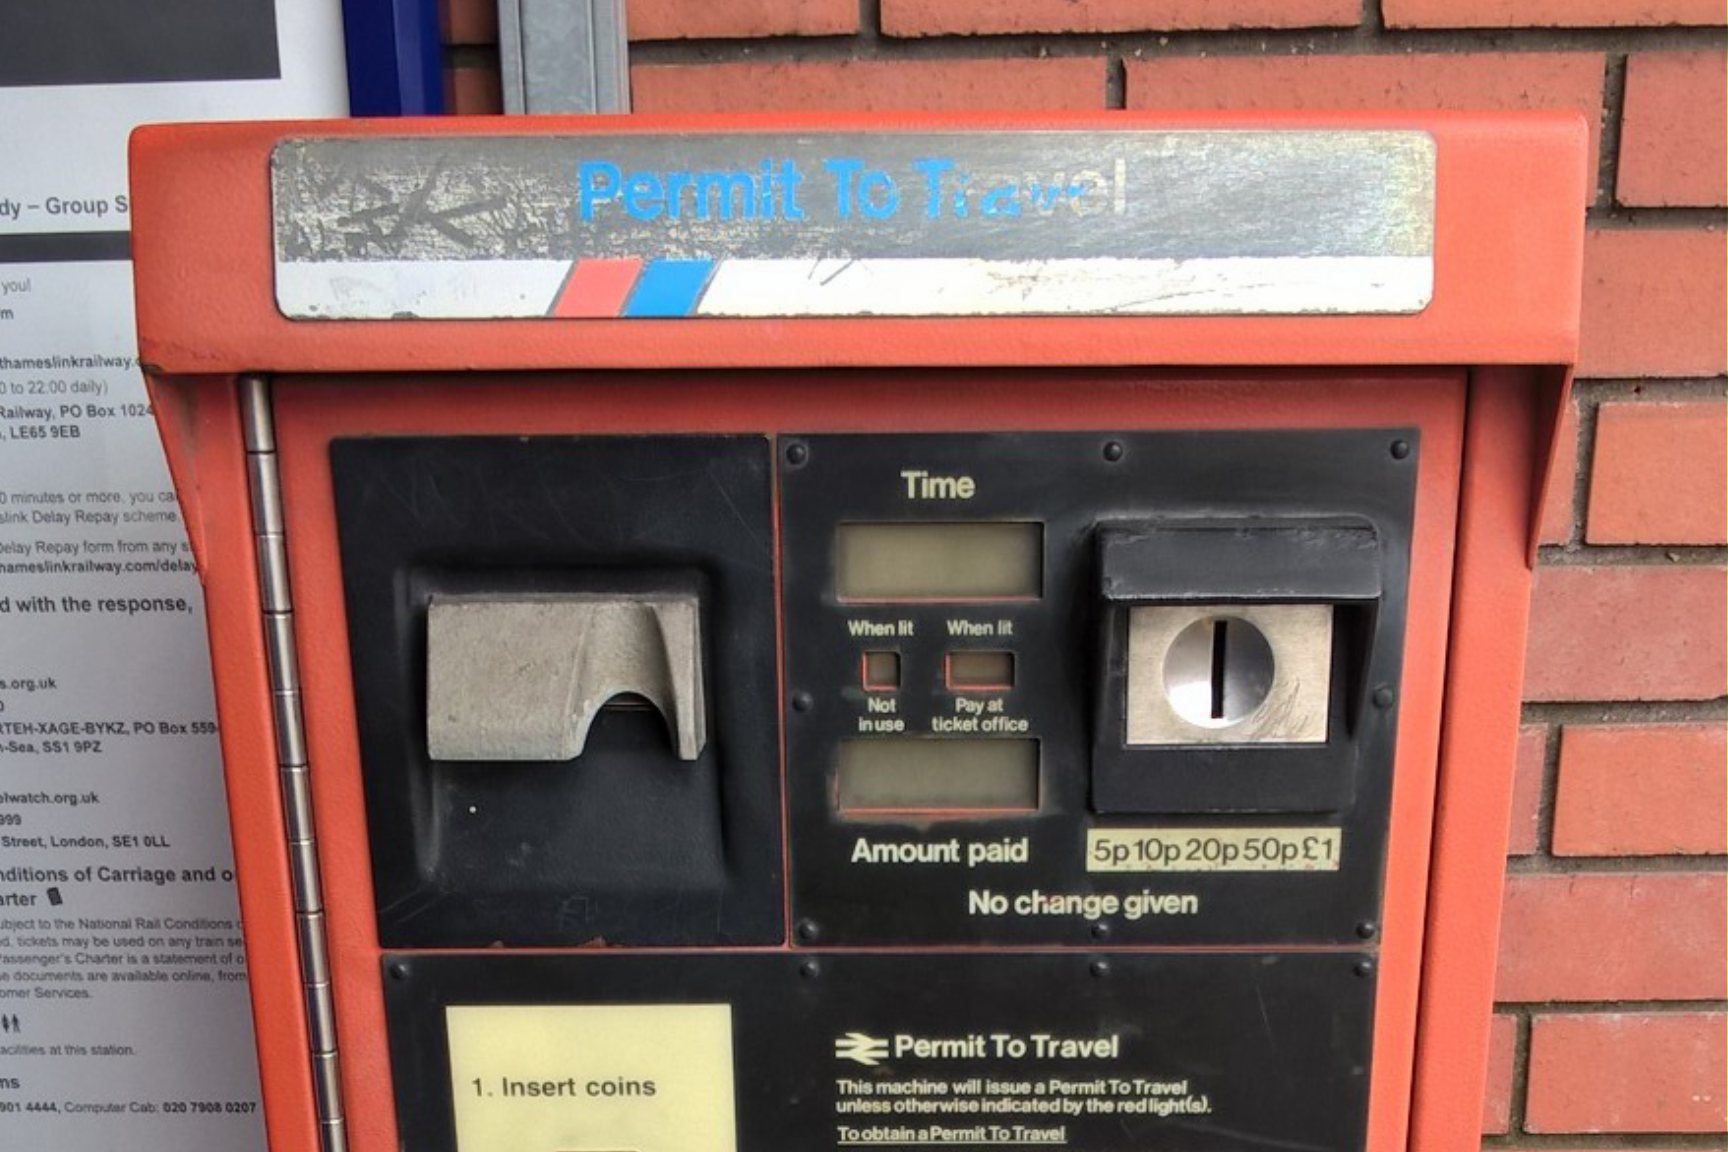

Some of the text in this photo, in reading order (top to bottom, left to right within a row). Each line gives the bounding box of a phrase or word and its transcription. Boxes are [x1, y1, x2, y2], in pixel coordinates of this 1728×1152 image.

[578, 158, 805, 221] Permit
[823, 158, 898, 219] To
[46, 197, 108, 218] Group
[10, 381, 24, 394] to
[71, 380, 108, 396] daily)
[60, 404, 116, 418] PO Box
[10, 425, 80, 439] LE65 9EB
[901, 471, 976, 499] Time
[11, 491, 154, 506] minutes or you
[32, 510, 119, 526] Delay Repay
[35, 540, 177, 556] Repay form from any
[16, 597, 192, 616] with the response,
[848, 620, 914, 636] When lit
[947, 620, 1013, 636] When lit
[868, 698, 896, 713] Not
[956, 698, 1003, 716] Pay at
[134, 722, 187, 736] PO Box
[858, 717, 905, 731] in use
[932, 717, 1029, 731] ticket office
[42, 741, 102, 753] SS1 9PZ
[2, 836, 171, 849] Street, London, SE1 0LL
[852, 837, 1029, 867] Amount paid
[1094, 836, 1333, 866] 5p 10p 20p 50p £1
[74, 867, 216, 885] of Carriage and
[968, 888, 1198, 920] No change given
[894, 1034, 1119, 1059] Permit To Travel
[472, 1076, 657, 1097] 1. Insert coins
[836, 1079, 1188, 1095] This machine will issue a Permit To Travel
[64, 1102, 126, 1115] Computer
[129, 1101, 159, 1113] Cab:
[163, 1102, 188, 1113] 020
[225, 1101, 257, 1113] 0207
[836, 1096, 1212, 1116] unless otherwise indicated by the red light(s).
[837, 1125, 1066, 1143] To obtain a Permit To Travel
